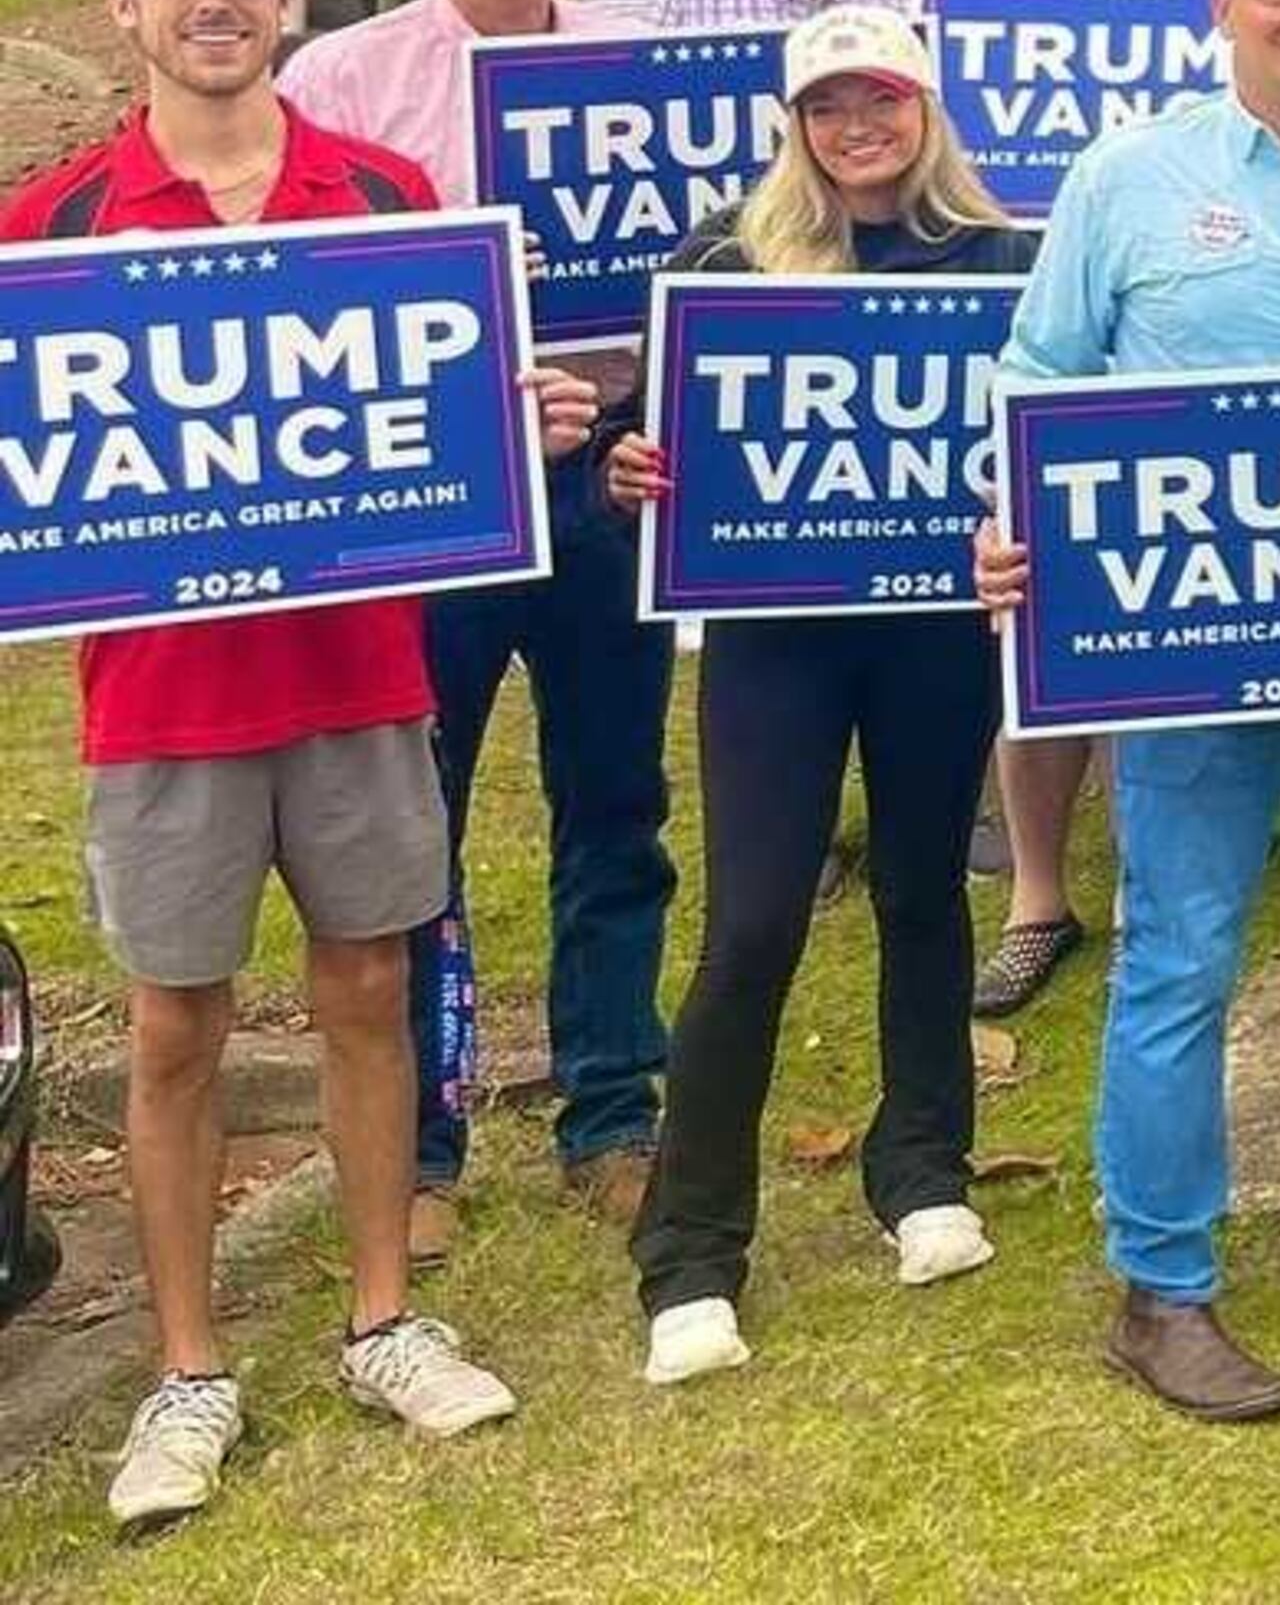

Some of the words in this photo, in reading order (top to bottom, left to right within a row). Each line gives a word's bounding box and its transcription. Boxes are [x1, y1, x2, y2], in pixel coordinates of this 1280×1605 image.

[947, 21, 1229, 83] TRUM
[503, 93, 790, 180] TRU
[982, 87, 1154, 137] VAN
[553, 174, 742, 243] VAN
[0, 300, 481, 422] RUMP
[695, 354, 1000, 432] TRU
[0, 399, 432, 508] VANCE
[0, 527, 64, 553] AKE
[75, 508, 227, 545] AMERICA
[239, 497, 343, 527] GREAT
[357, 482, 468, 514] AGAIN!
[711, 520, 788, 541] MAKE
[796, 518, 916, 539] AMERICA
[926, 516, 978, 536] GRE
[176, 566, 283, 602] 2024
[869, 573, 954, 597] 2024
[1073, 629, 1153, 655] MAKE
